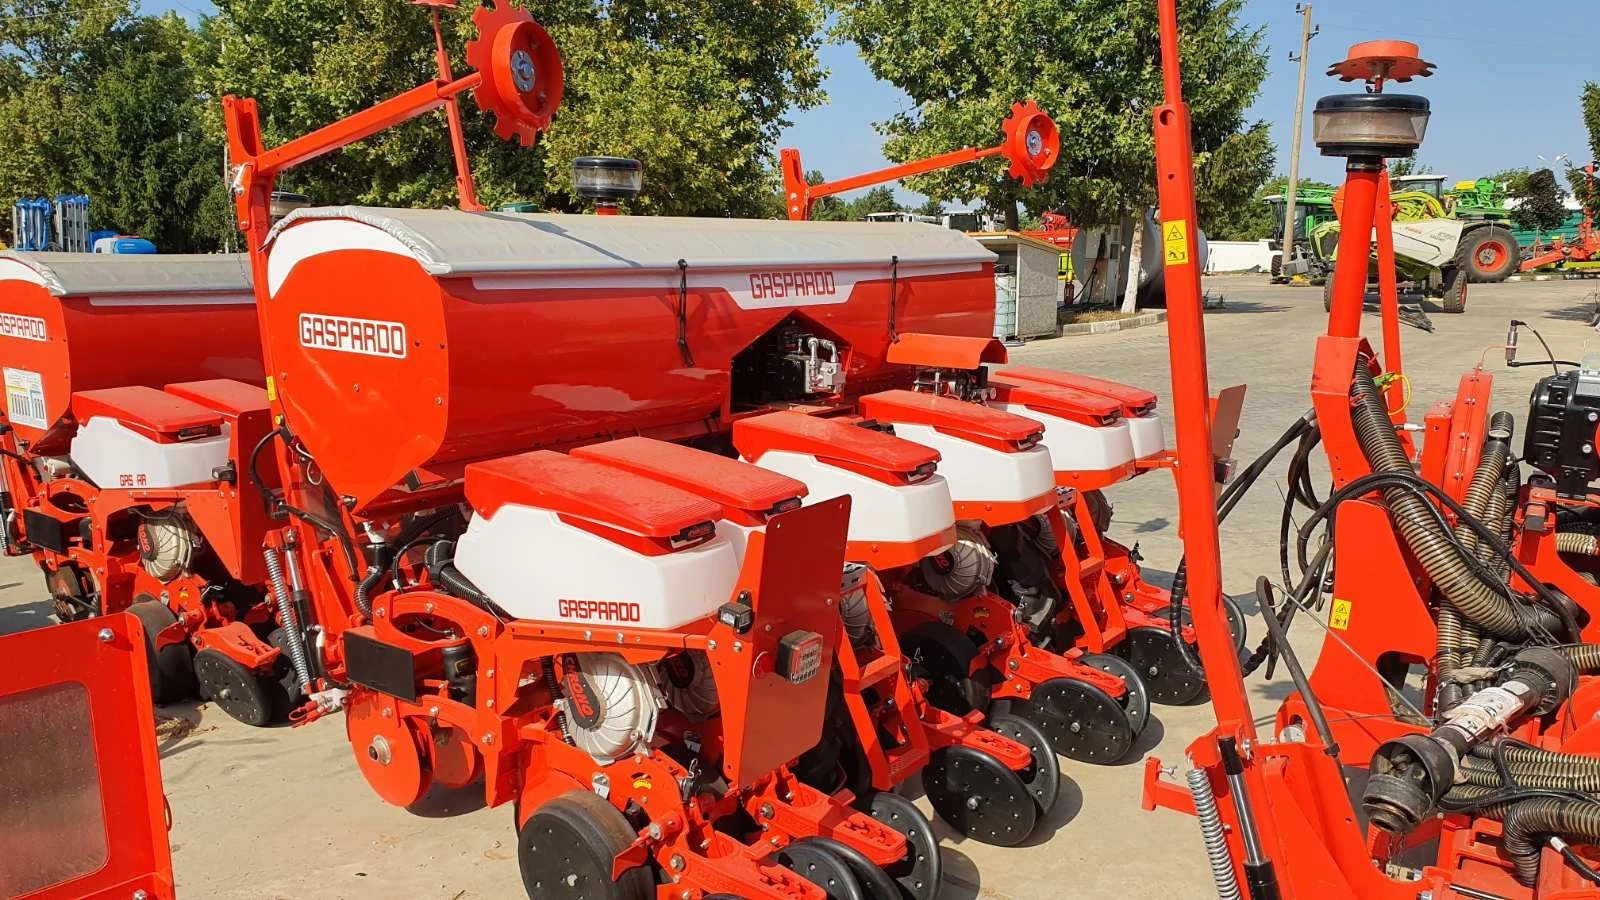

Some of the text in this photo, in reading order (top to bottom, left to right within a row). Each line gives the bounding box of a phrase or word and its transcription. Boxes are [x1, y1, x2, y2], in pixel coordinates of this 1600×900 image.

[750, 271, 835, 299] GASPARDO
[0, 314, 46, 340] ASPARDO
[301, 316, 404, 355] GASPARDO
[558, 599, 640, 622] GASPARDO
[564, 656, 594, 718] CHRONO
